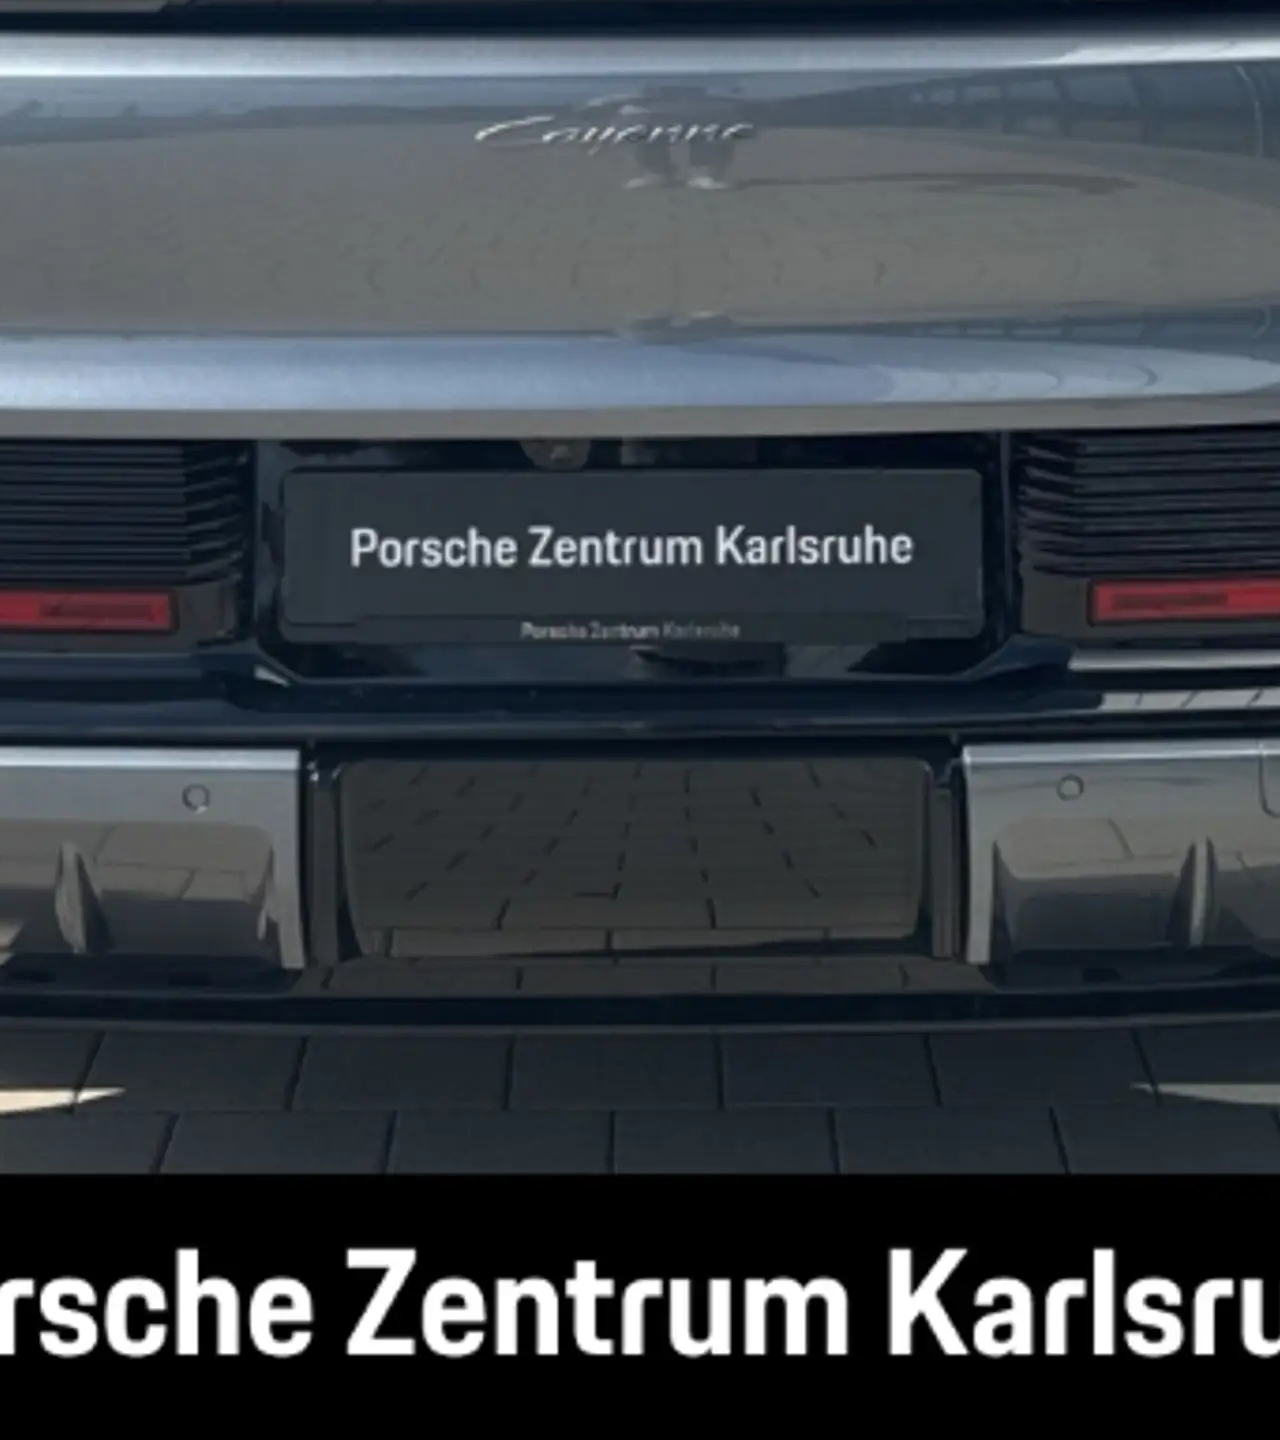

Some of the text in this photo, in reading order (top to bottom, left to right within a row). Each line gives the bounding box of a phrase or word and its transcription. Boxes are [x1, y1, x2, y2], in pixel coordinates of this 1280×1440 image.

[474, 115, 754, 155] Cayenne
[351, 525, 913, 567] Porsche Zentrum Karlsruhe
[521, 621, 588, 639] Porsche
[590, 621, 660, 639] Zentrum
